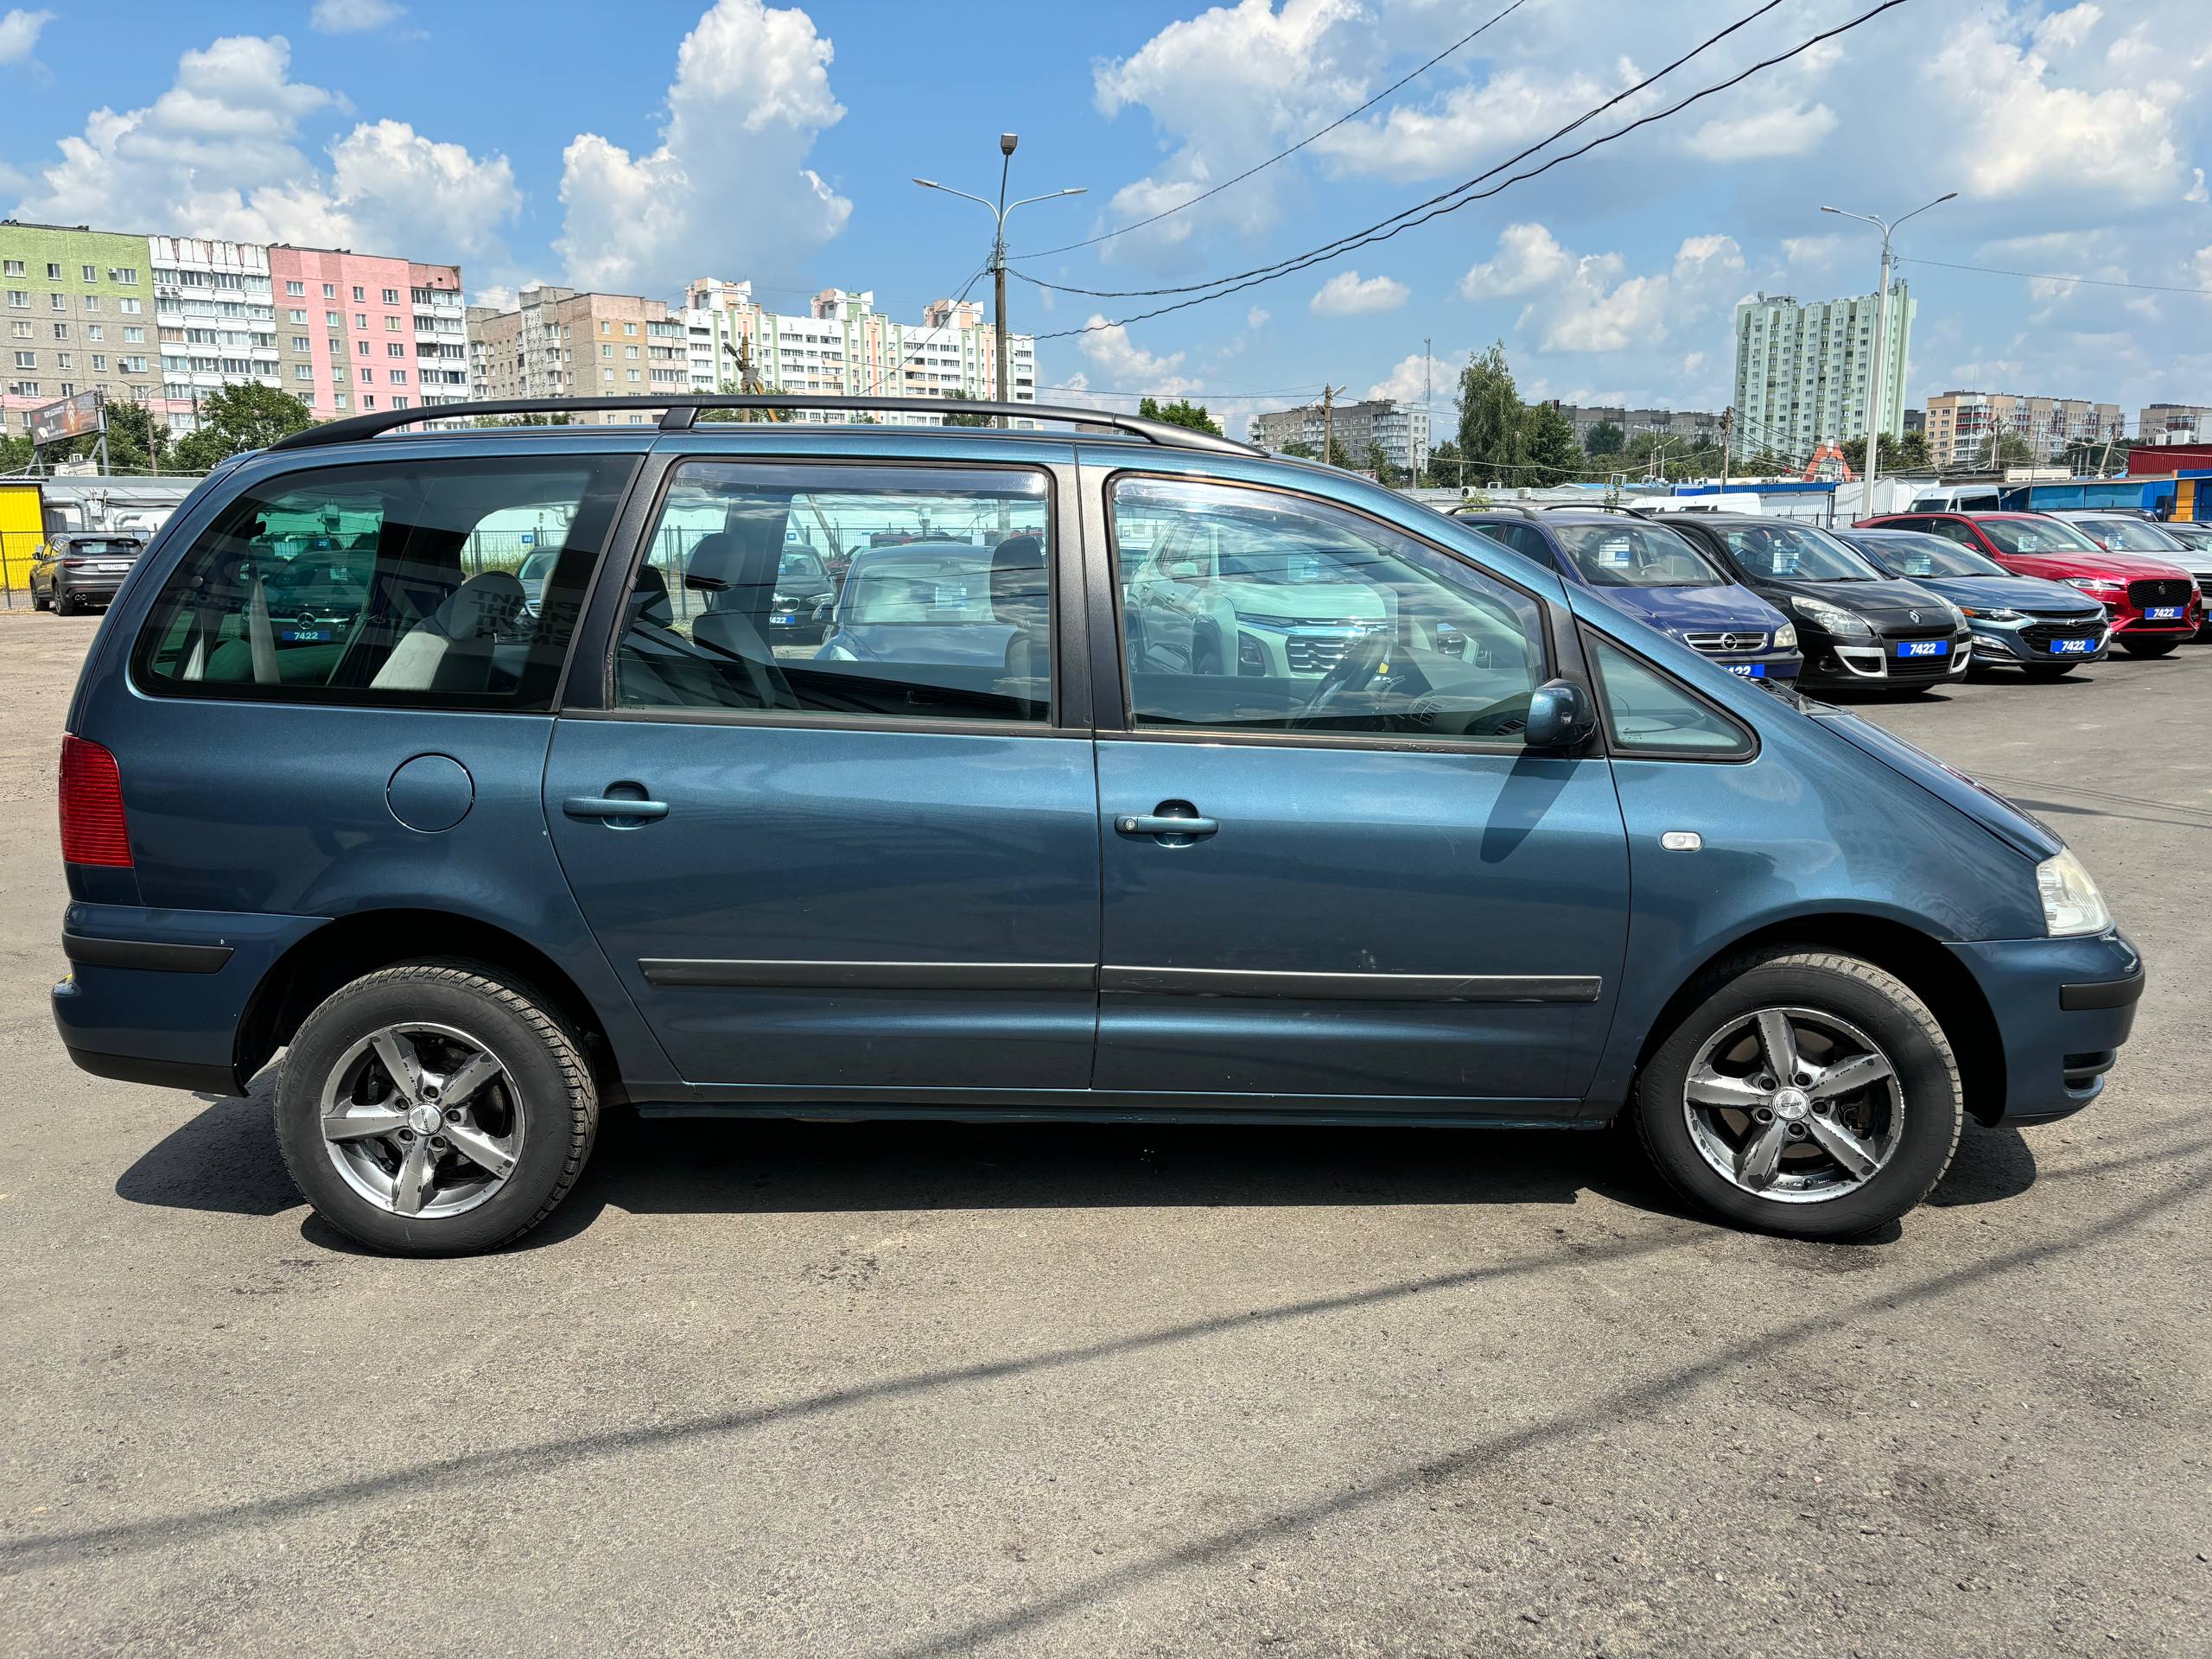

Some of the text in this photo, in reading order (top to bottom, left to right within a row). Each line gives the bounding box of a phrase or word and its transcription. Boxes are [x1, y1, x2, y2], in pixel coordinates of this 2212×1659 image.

[2153, 608, 2175, 618] 7422
[294, 632, 319, 640] 7422
[1910, 643, 1936, 655] 7422
[2061, 640, 2086, 652] 7422
